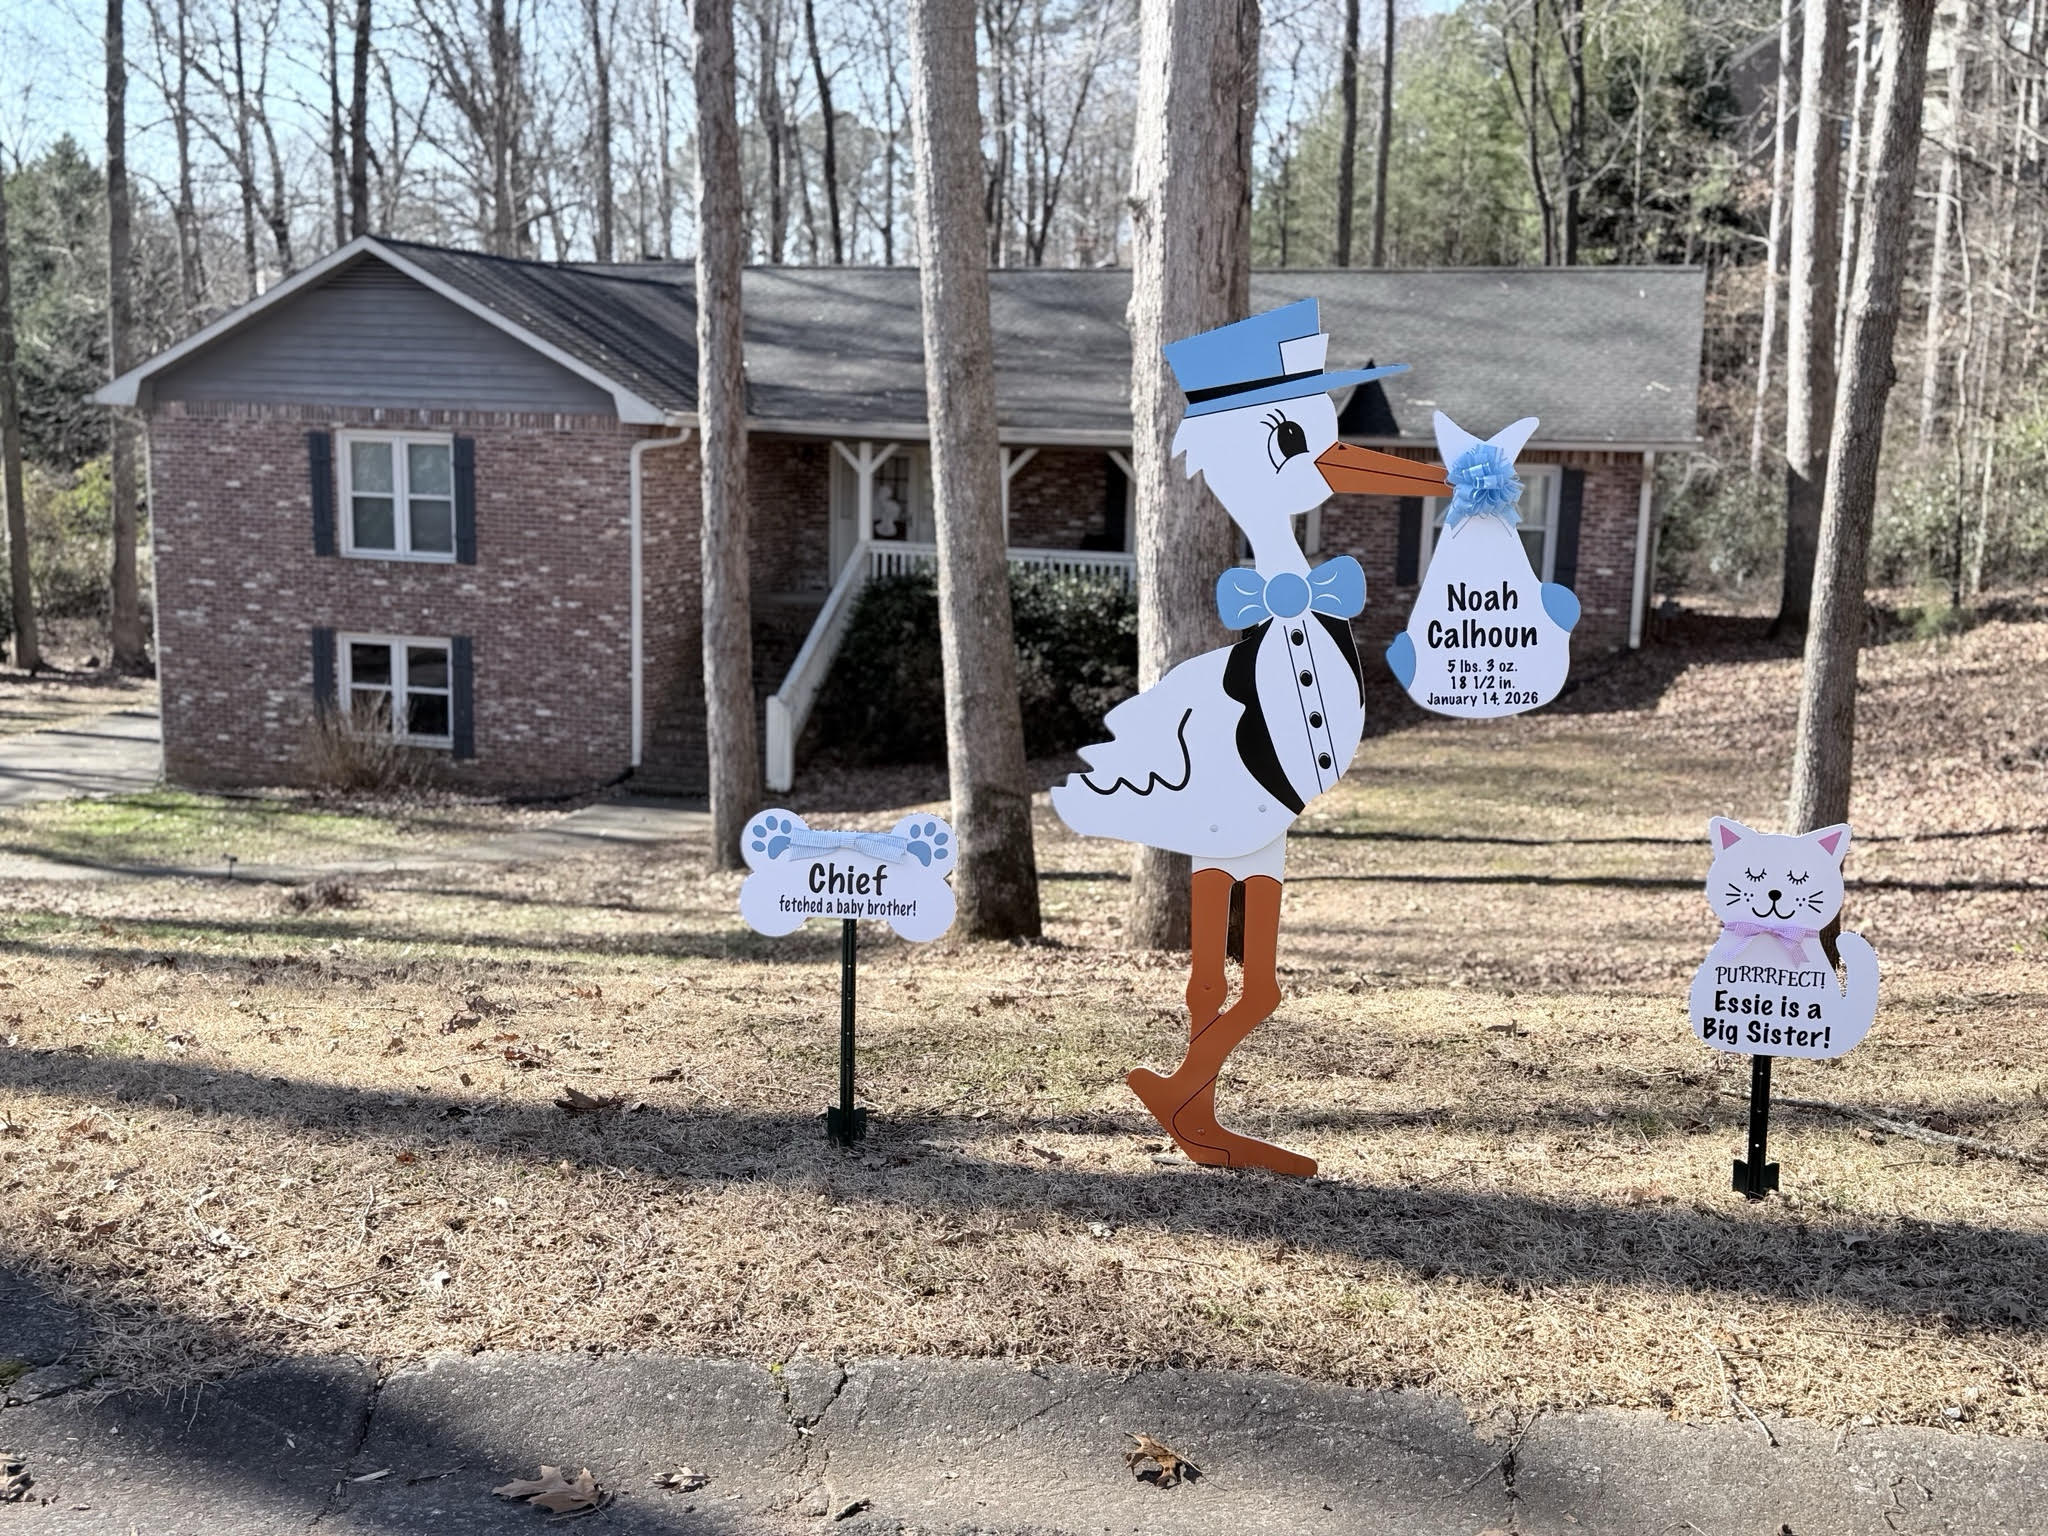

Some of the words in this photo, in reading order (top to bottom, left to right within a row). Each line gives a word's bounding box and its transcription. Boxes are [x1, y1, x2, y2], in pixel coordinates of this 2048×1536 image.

[1448, 581, 1518, 612] Noah
[1428, 619, 1537, 648] Calhoun
[1448, 660, 1456, 673] 5
[1461, 659, 1481, 673] lbs.
[1487, 659, 1494, 672] 3
[1499, 662, 1517, 672] oz.
[1451, 676, 1466, 689] 18
[1474, 676, 1494, 689] 1/2
[1500, 676, 1515, 689] in.
[1427, 692, 1477, 707] January
[1483, 692, 1500, 705] 14,
[1505, 692, 1538, 704] 2026
[809, 863, 887, 895] Chief
[779, 895, 822, 913] fetched
[826, 902, 833, 913] a
[837, 898, 864, 917] baby
[868, 899, 916, 916] brother!
[1715, 966, 1825, 989] PURRRFECT!
[1715, 990, 1773, 1015] Essie
[1781, 996, 1799, 1018] is
[1808, 1004, 1821, 1019] a
[1703, 1017, 1738, 1045] Big
[1746, 1021, 1830, 1049] Sister!
